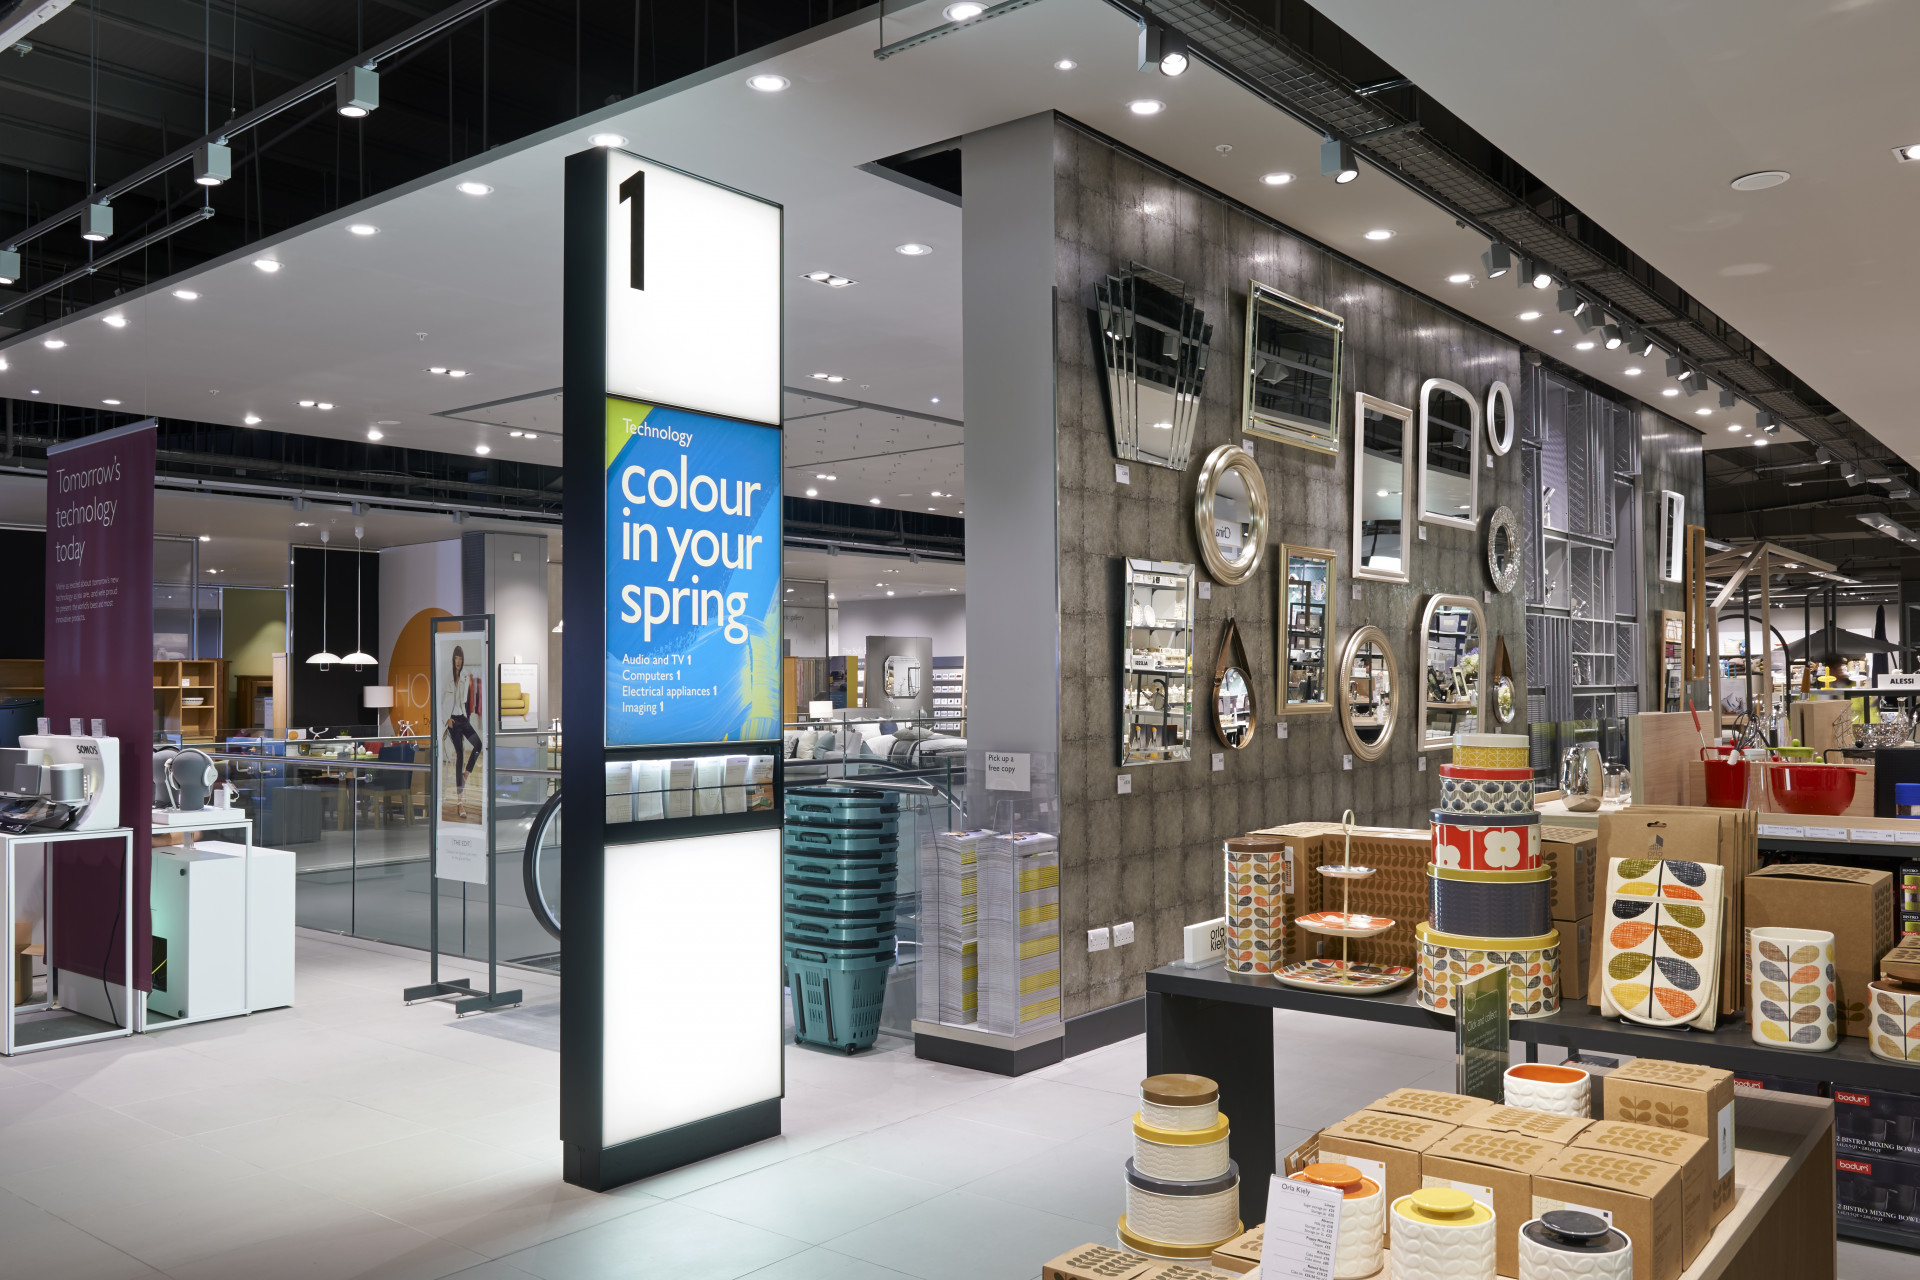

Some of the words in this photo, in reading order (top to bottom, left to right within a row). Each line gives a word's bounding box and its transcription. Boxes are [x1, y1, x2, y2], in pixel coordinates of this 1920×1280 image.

[619, 170, 645, 291] 1
[622, 417, 693, 448] Technology
[56, 456, 121, 494] Tomorrow's
[621, 454, 762, 517] colour
[56, 496, 117, 528] technology
[56, 535, 86, 566] today
[622, 507, 658, 563] in
[666, 526, 763, 582] your
[621, 574, 749, 645] spring
[622, 653, 650, 665] Audio
[653, 654, 669, 665] and
[671, 654, 684, 665] TV
[687, 654, 692, 665] 1
[622, 669, 674, 684] Computers
[676, 669, 681, 681] 1
[622, 685, 664, 697] Electrical
[666, 685, 711, 700] appliances
[713, 685, 718, 696] 1
[622, 701, 657, 716] Imaging
[659, 701, 664, 712] 1
[988, 754, 1001, 762] Pick
[988, 764, 1000, 772] free
[1001, 766, 1016, 775] copy
[1210, 926, 1225, 940] orla
[1837, 1093, 1867, 1104] bodum
[1842, 1137, 1867, 1145] BISTRO
[1868, 1141, 1895, 1150] MIXING
[1839, 1161, 1869, 1172] bodum
[1281, 1183, 1294, 1192] Orla
[1296, 1186, 1310, 1196] Kiely
[1843, 1204, 1868, 1213] BISTRO
[1869, 1209, 1897, 1219] MIXING
